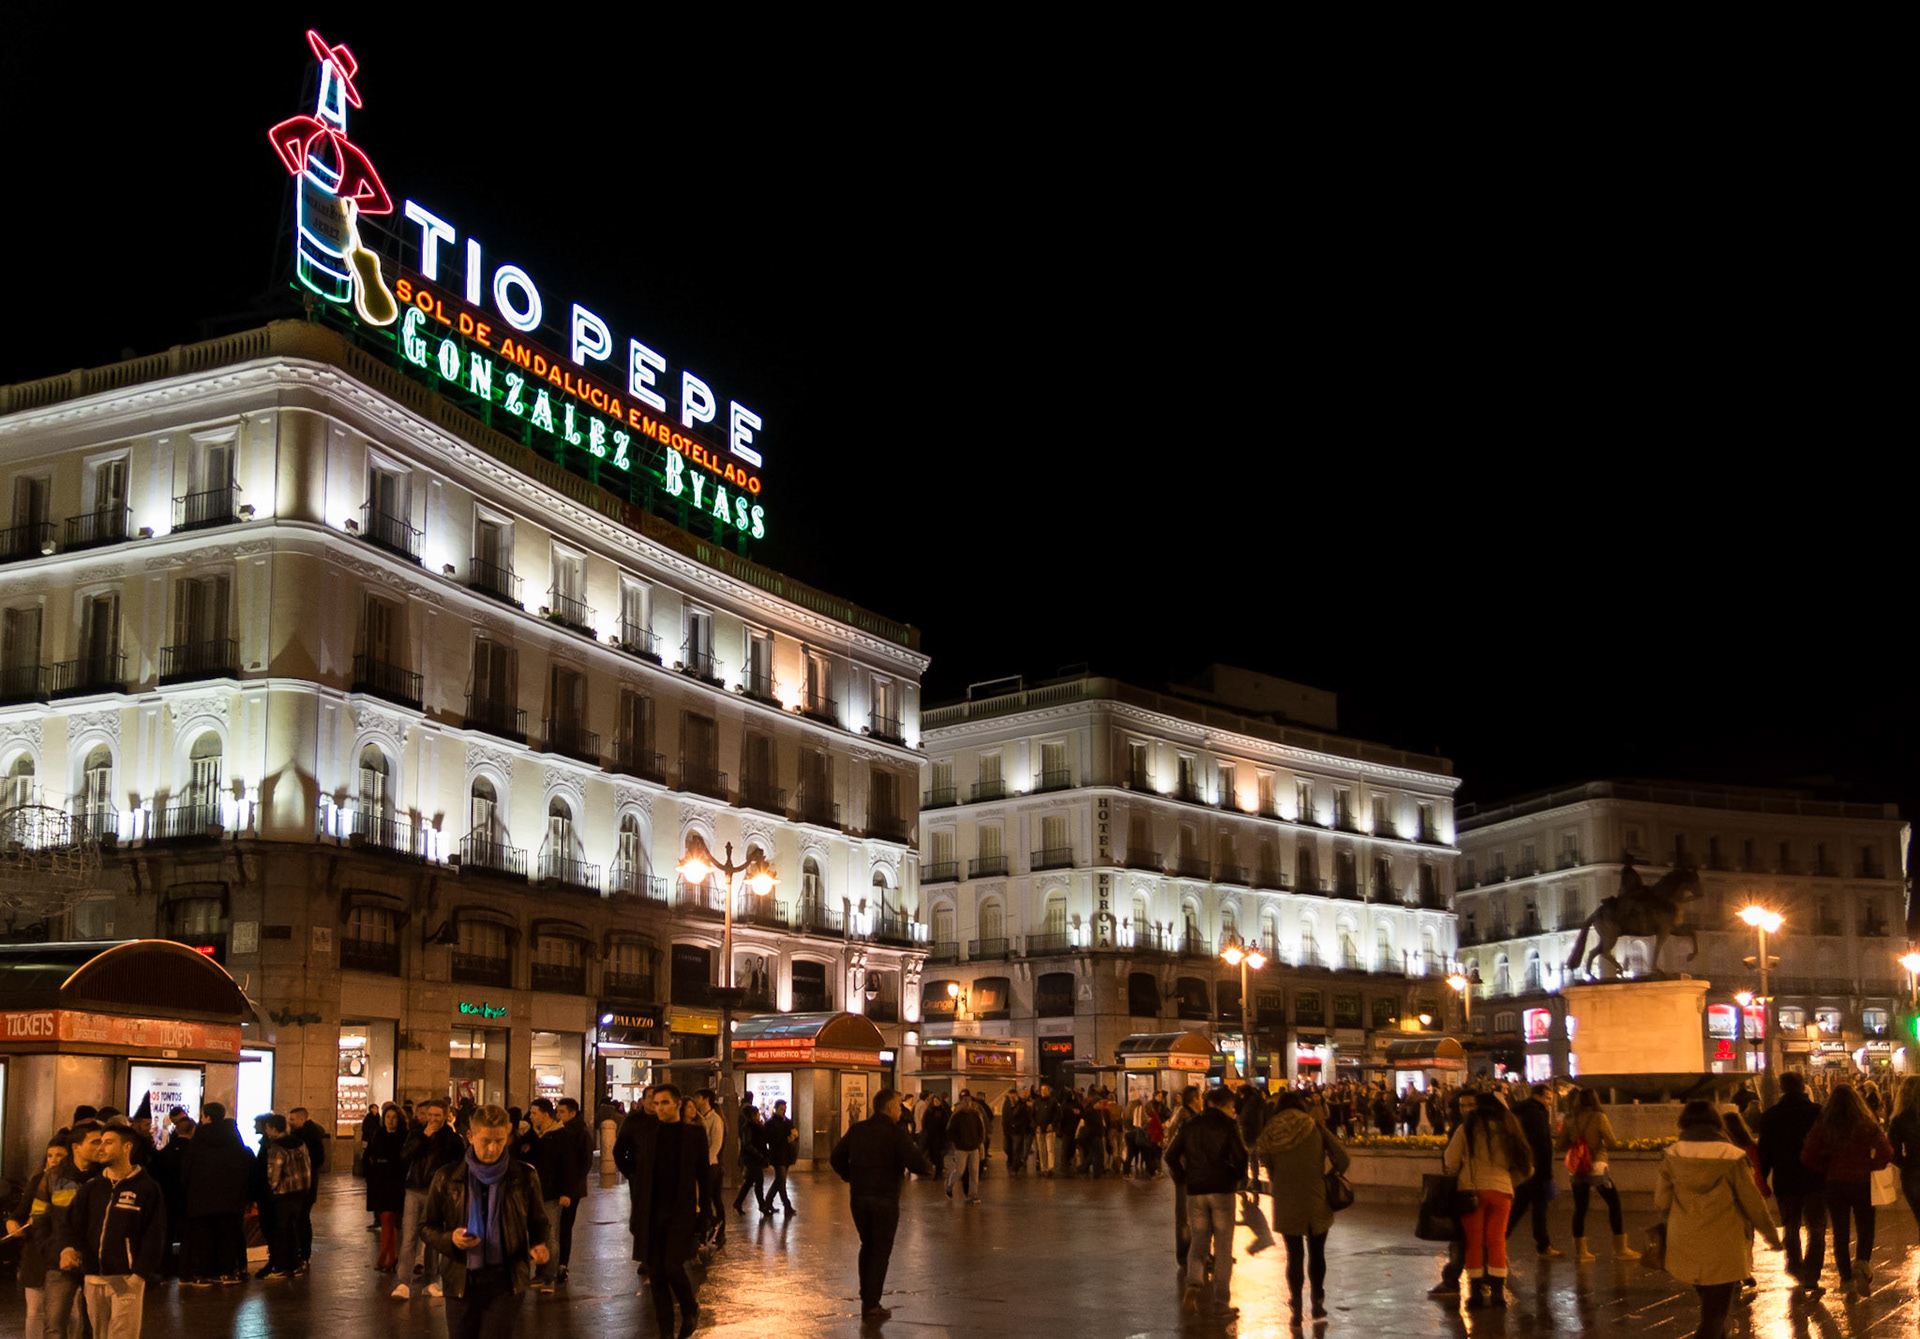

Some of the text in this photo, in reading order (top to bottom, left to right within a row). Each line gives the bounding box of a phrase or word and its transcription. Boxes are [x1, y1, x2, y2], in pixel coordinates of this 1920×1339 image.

[404, 198, 763, 468] TIO PEPE
[396, 278, 761, 495] SOL DE ANDALUCIA EMBOTELLADO
[402, 305, 765, 540] GONZALEZ BYASS
[1098, 798, 1109, 859] HOTEL
[1098, 874, 1110, 948] EUROPA
[5, 1013, 54, 1036] TICKETS
[613, 1014, 654, 1028] PALAZZO
[159, 1023, 194, 1047] TICKETS
[623, 1050, 648, 1058] PALAZZO
[757, 1051, 769, 1059] BUS
[1042, 1041, 1072, 1053] Orange
[161, 1091, 182, 1102] TONTOS
